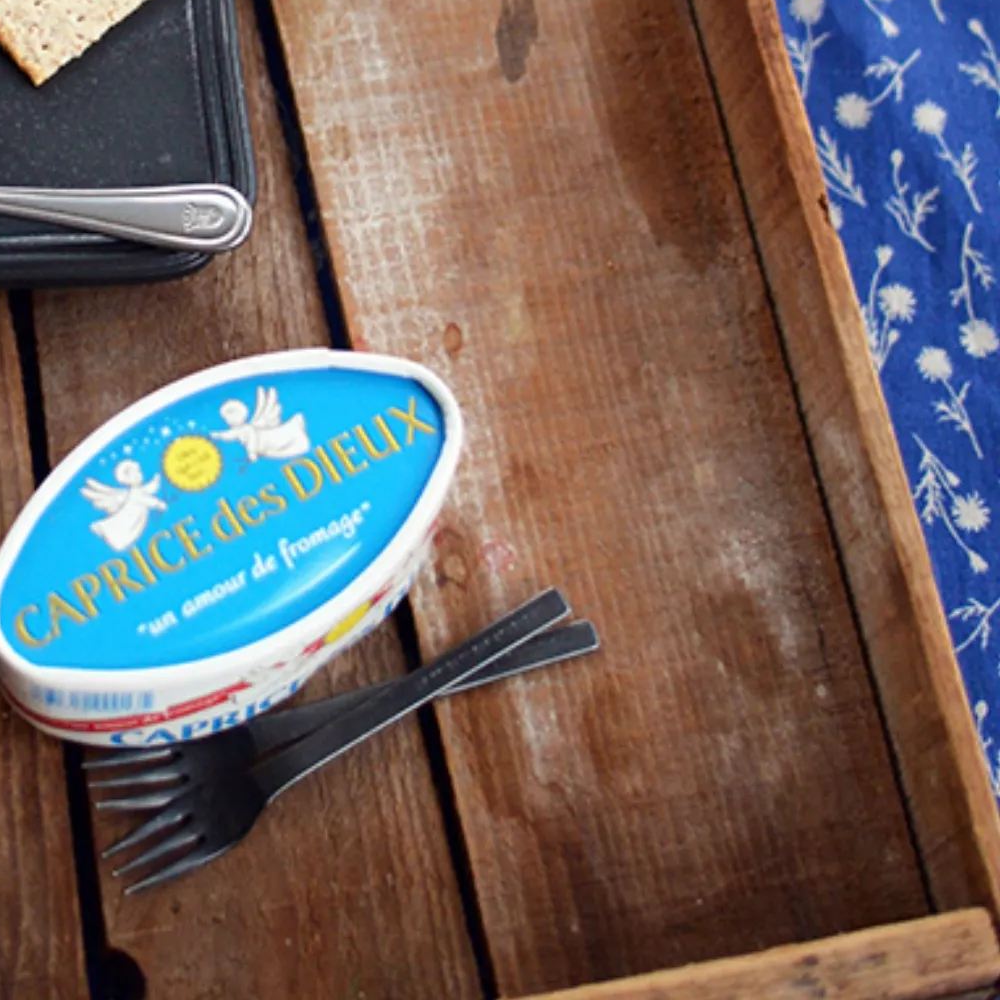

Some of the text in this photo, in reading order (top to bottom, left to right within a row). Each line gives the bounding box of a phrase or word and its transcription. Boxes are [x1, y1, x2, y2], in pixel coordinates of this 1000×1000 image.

[13, 514, 214, 649] CAPRICE
[211, 482, 288, 542] des
[281, 396, 437, 502] DIEUX
[181, 570, 248, 619] amour
[251, 552, 278, 581] de
